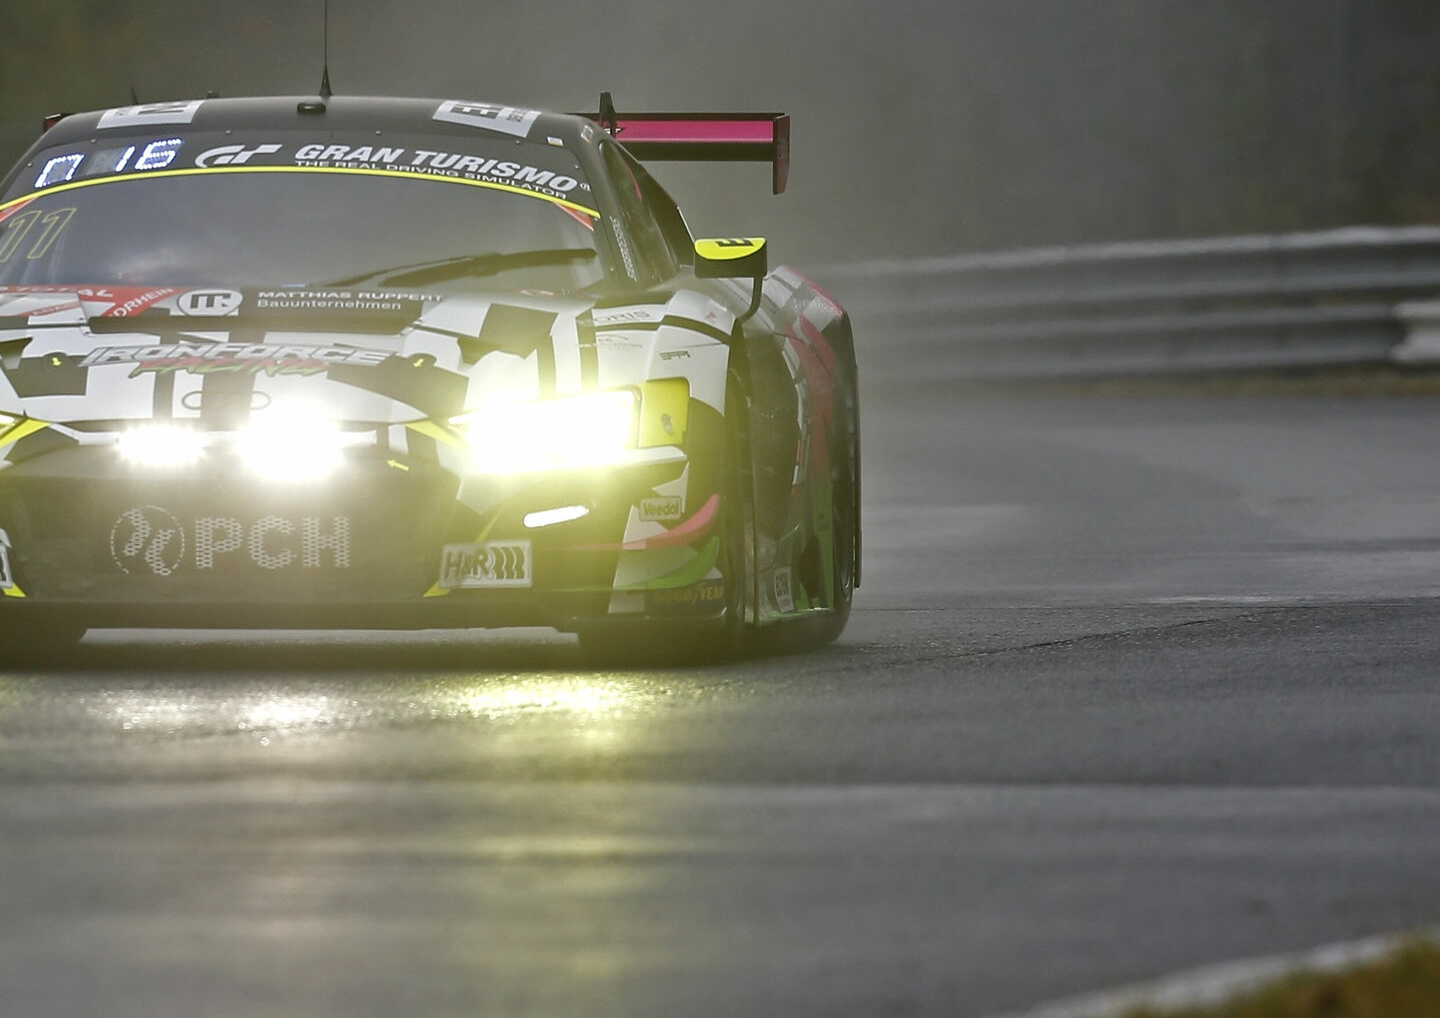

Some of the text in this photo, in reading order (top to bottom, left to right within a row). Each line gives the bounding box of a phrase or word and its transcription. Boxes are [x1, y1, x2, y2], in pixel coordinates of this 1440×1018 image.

[295, 143, 405, 164] GRAN
[413, 149, 579, 193] TURISMO
[295, 160, 568, 201] THE REAL DRIVING SIMULATOR
[257, 299, 402, 310] Bauunternehmen
[259, 291, 351, 299] MATTHIAS
[195, 516, 353, 570] PCH
[444, 552, 491, 581] H&R
